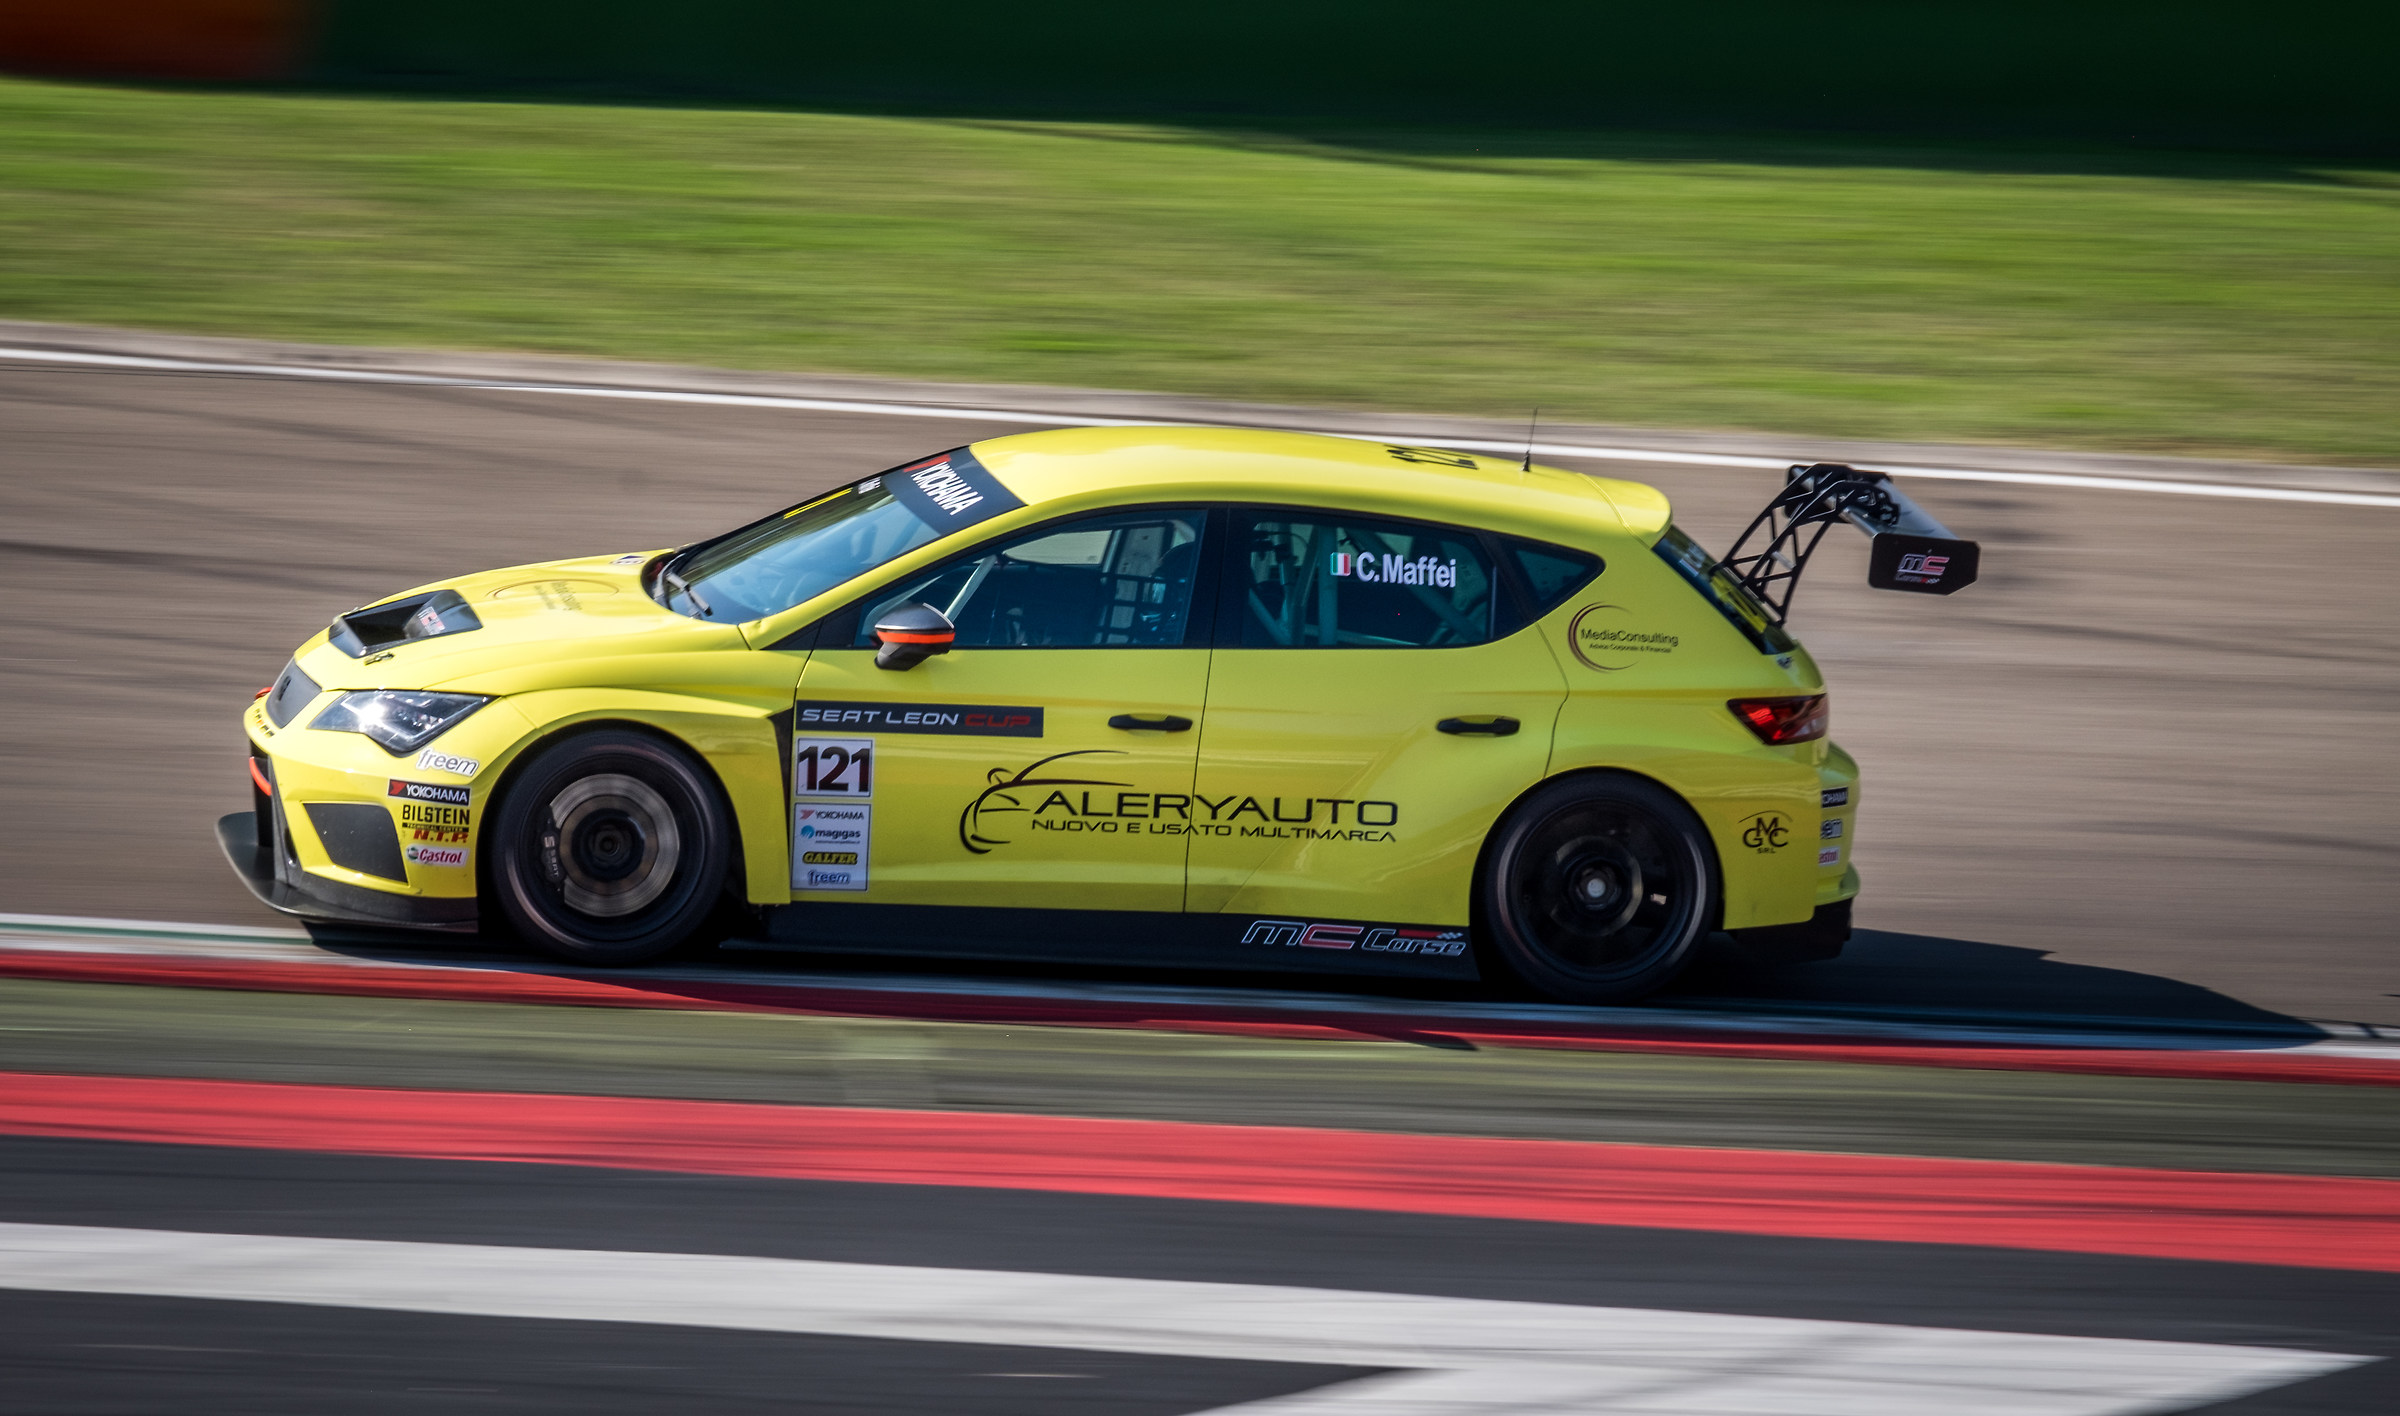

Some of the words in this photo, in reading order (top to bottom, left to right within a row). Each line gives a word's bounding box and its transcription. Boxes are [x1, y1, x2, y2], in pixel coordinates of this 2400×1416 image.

[1581, 628, 1679, 647] MediaConsulting
[802, 709, 881, 723] SEAT
[885, 711, 959, 726] LEON
[965, 714, 1031, 728] CUP
[418, 749, 477, 775] freem
[799, 746, 871, 792] 121
[406, 784, 468, 802] YOKOHAMA
[402, 804, 470, 825] BILSTEIN
[815, 810, 864, 819] YOKOHAMA
[1034, 790, 1398, 826] ALERYAUTO
[815, 829, 861, 840] magigas
[1032, 819, 1118, 833] NUOVO
[1127, 822, 1141, 833] E
[1149, 823, 1232, 836] USATO
[1240, 826, 1396, 842] MULTIMARCA
[419, 848, 462, 863] Castrol
[804, 852, 857, 864] GALFER
[808, 869, 850, 885] freem
